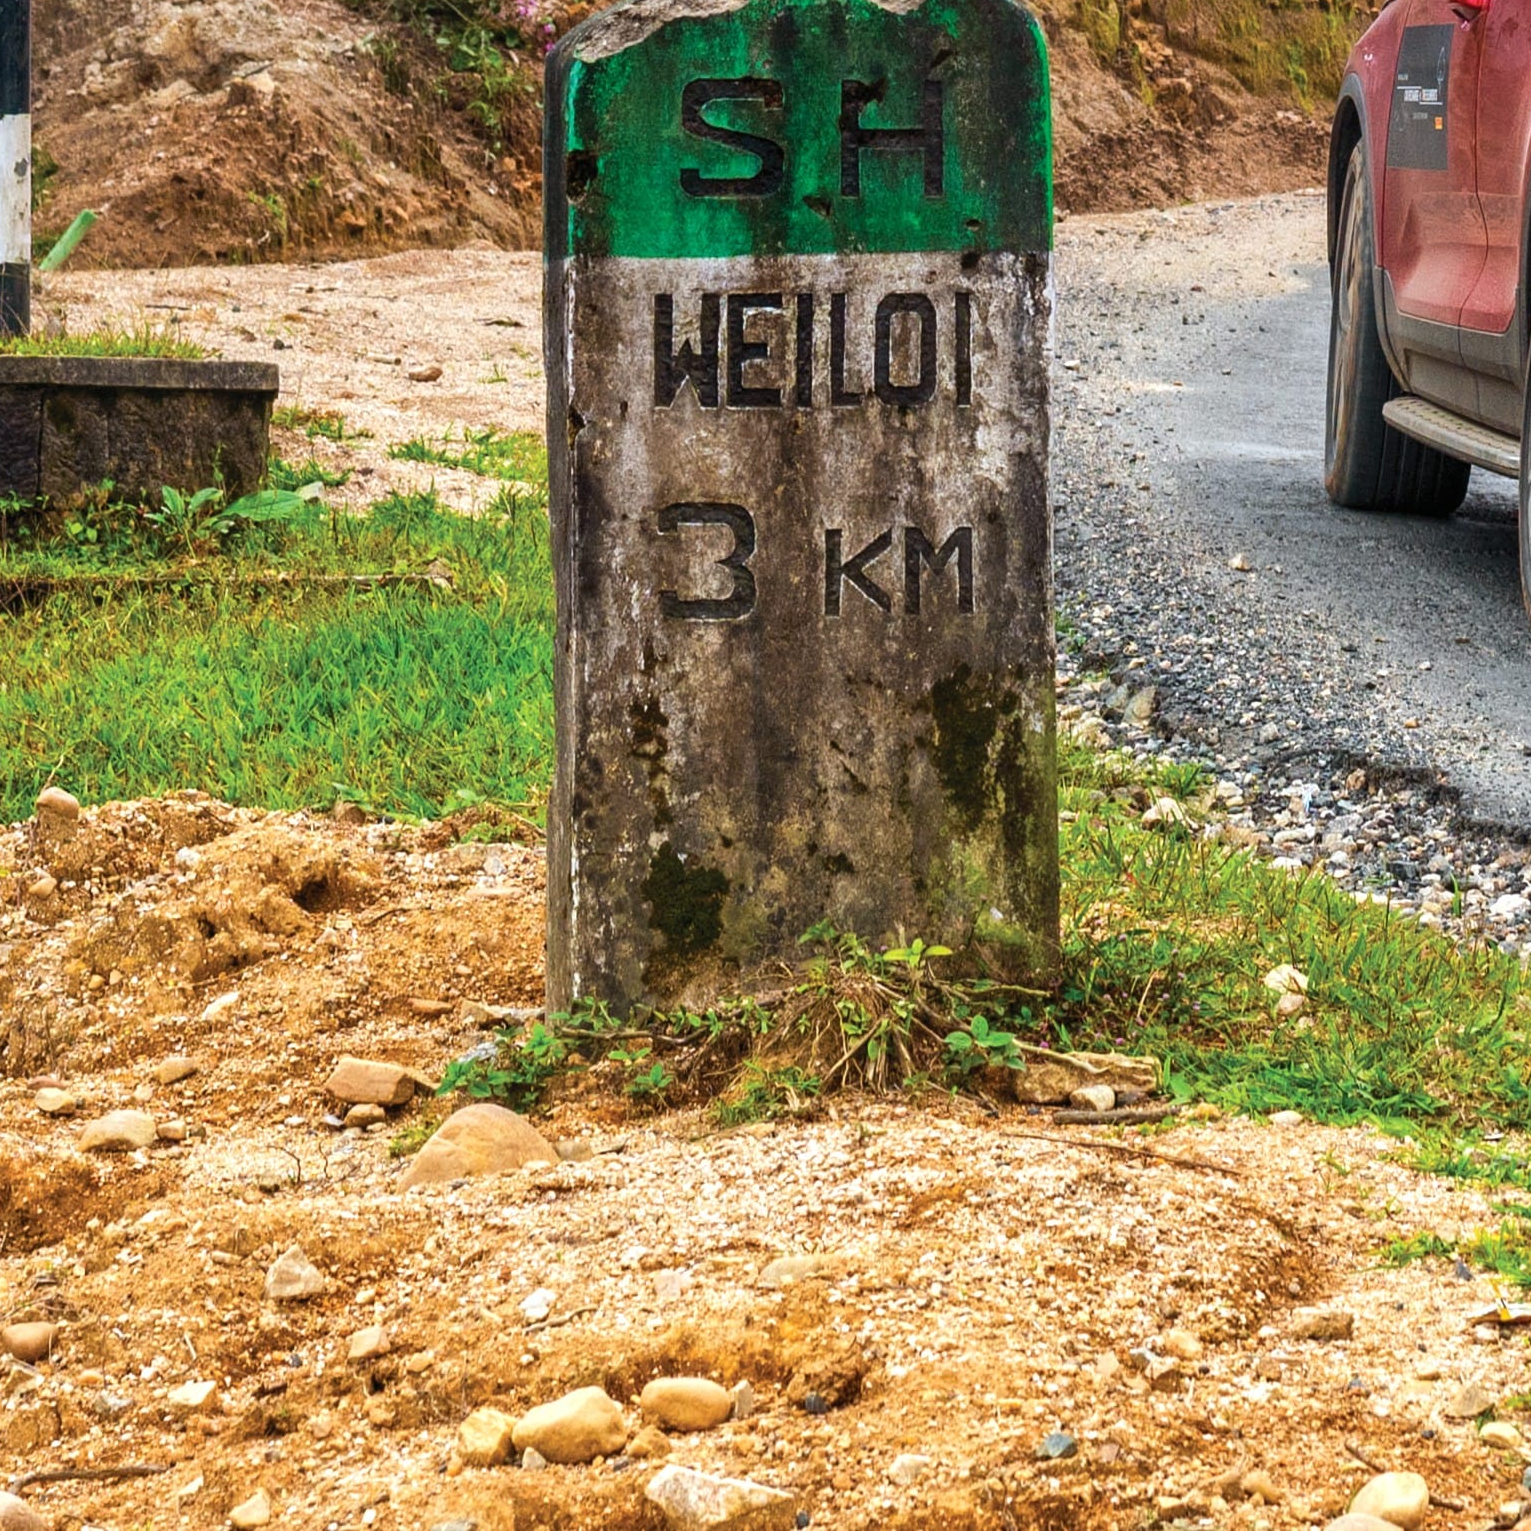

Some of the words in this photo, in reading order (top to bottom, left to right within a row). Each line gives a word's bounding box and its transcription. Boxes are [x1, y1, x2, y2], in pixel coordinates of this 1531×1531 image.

[680, 78, 944, 198] SH
[653, 291, 973, 408] WEILOI
[658, 501, 757, 621] 3
[824, 527, 974, 618] KM
